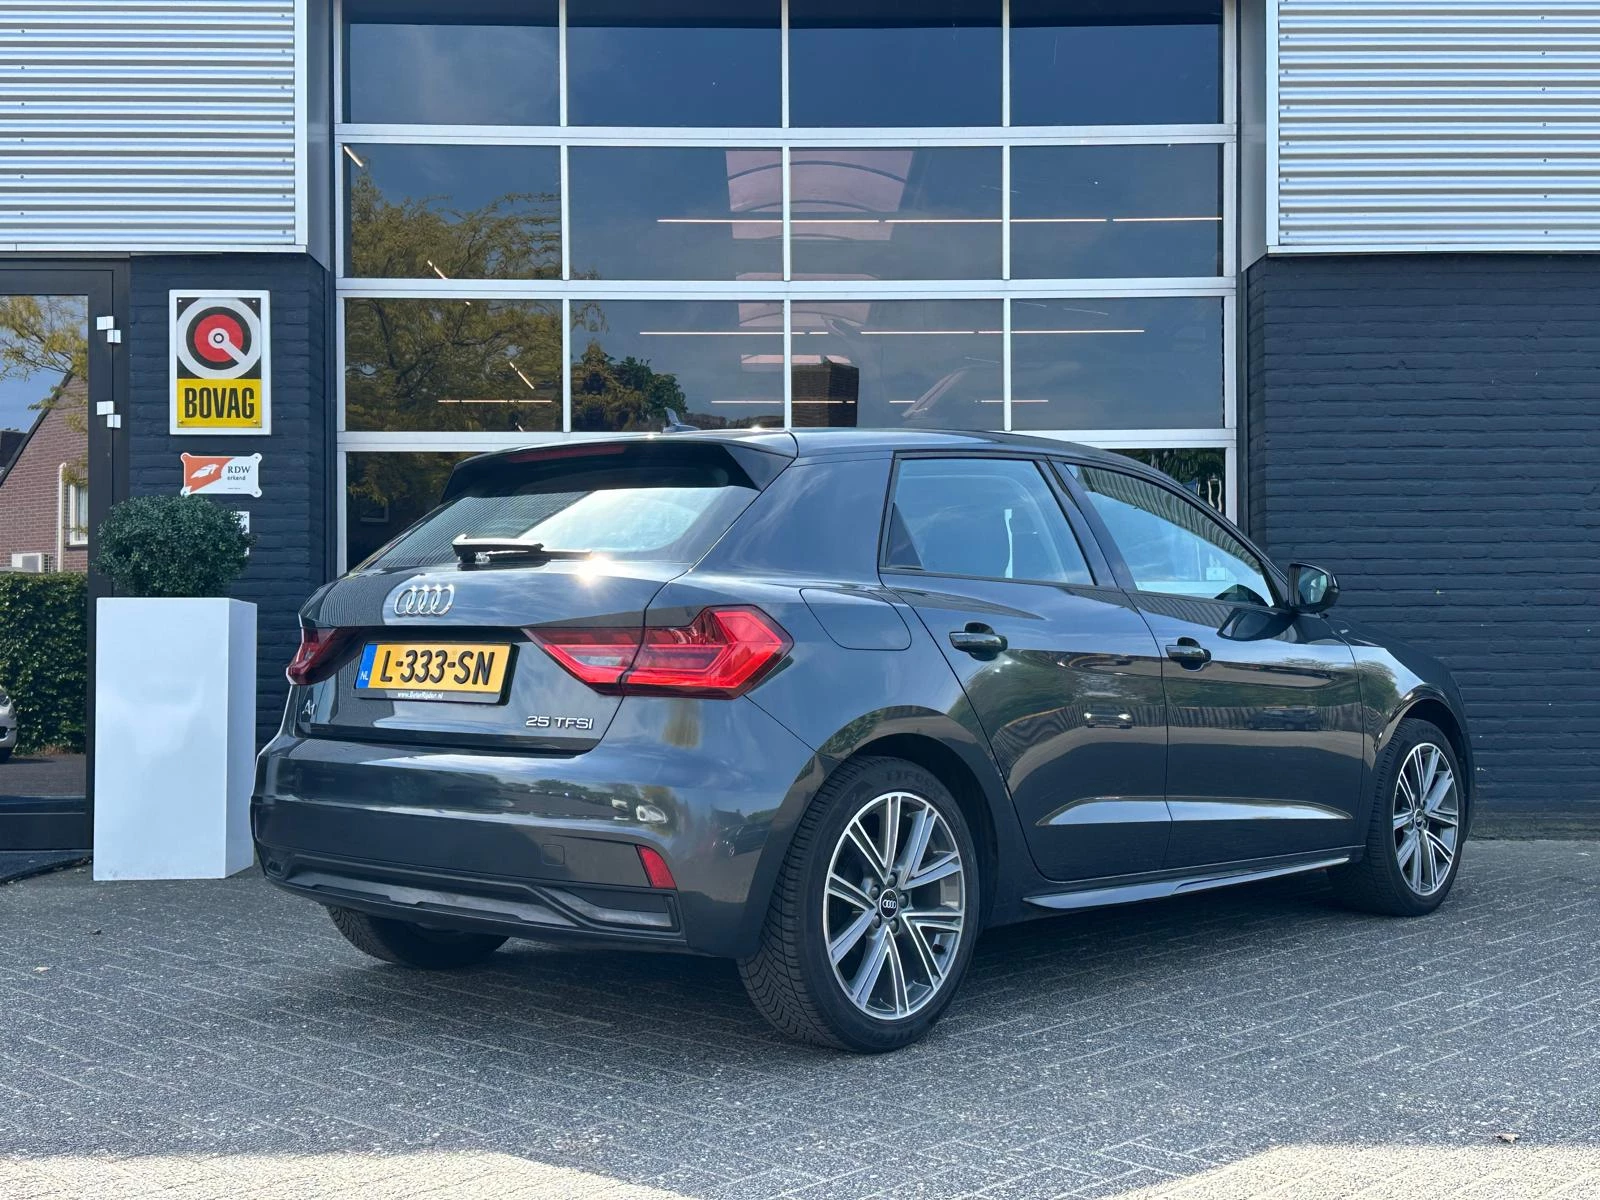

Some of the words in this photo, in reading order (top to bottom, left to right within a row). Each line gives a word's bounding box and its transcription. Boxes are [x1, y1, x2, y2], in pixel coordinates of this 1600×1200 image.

[184, 387, 255, 419] BOVAG
[227, 465, 251, 474] RDW
[360, 671, 369, 681] NL
[380, 650, 495, 685] L-333-SN
[302, 699, 316, 715] A1
[525, 715, 551, 728] 25
[554, 716, 594, 730] TFSI
